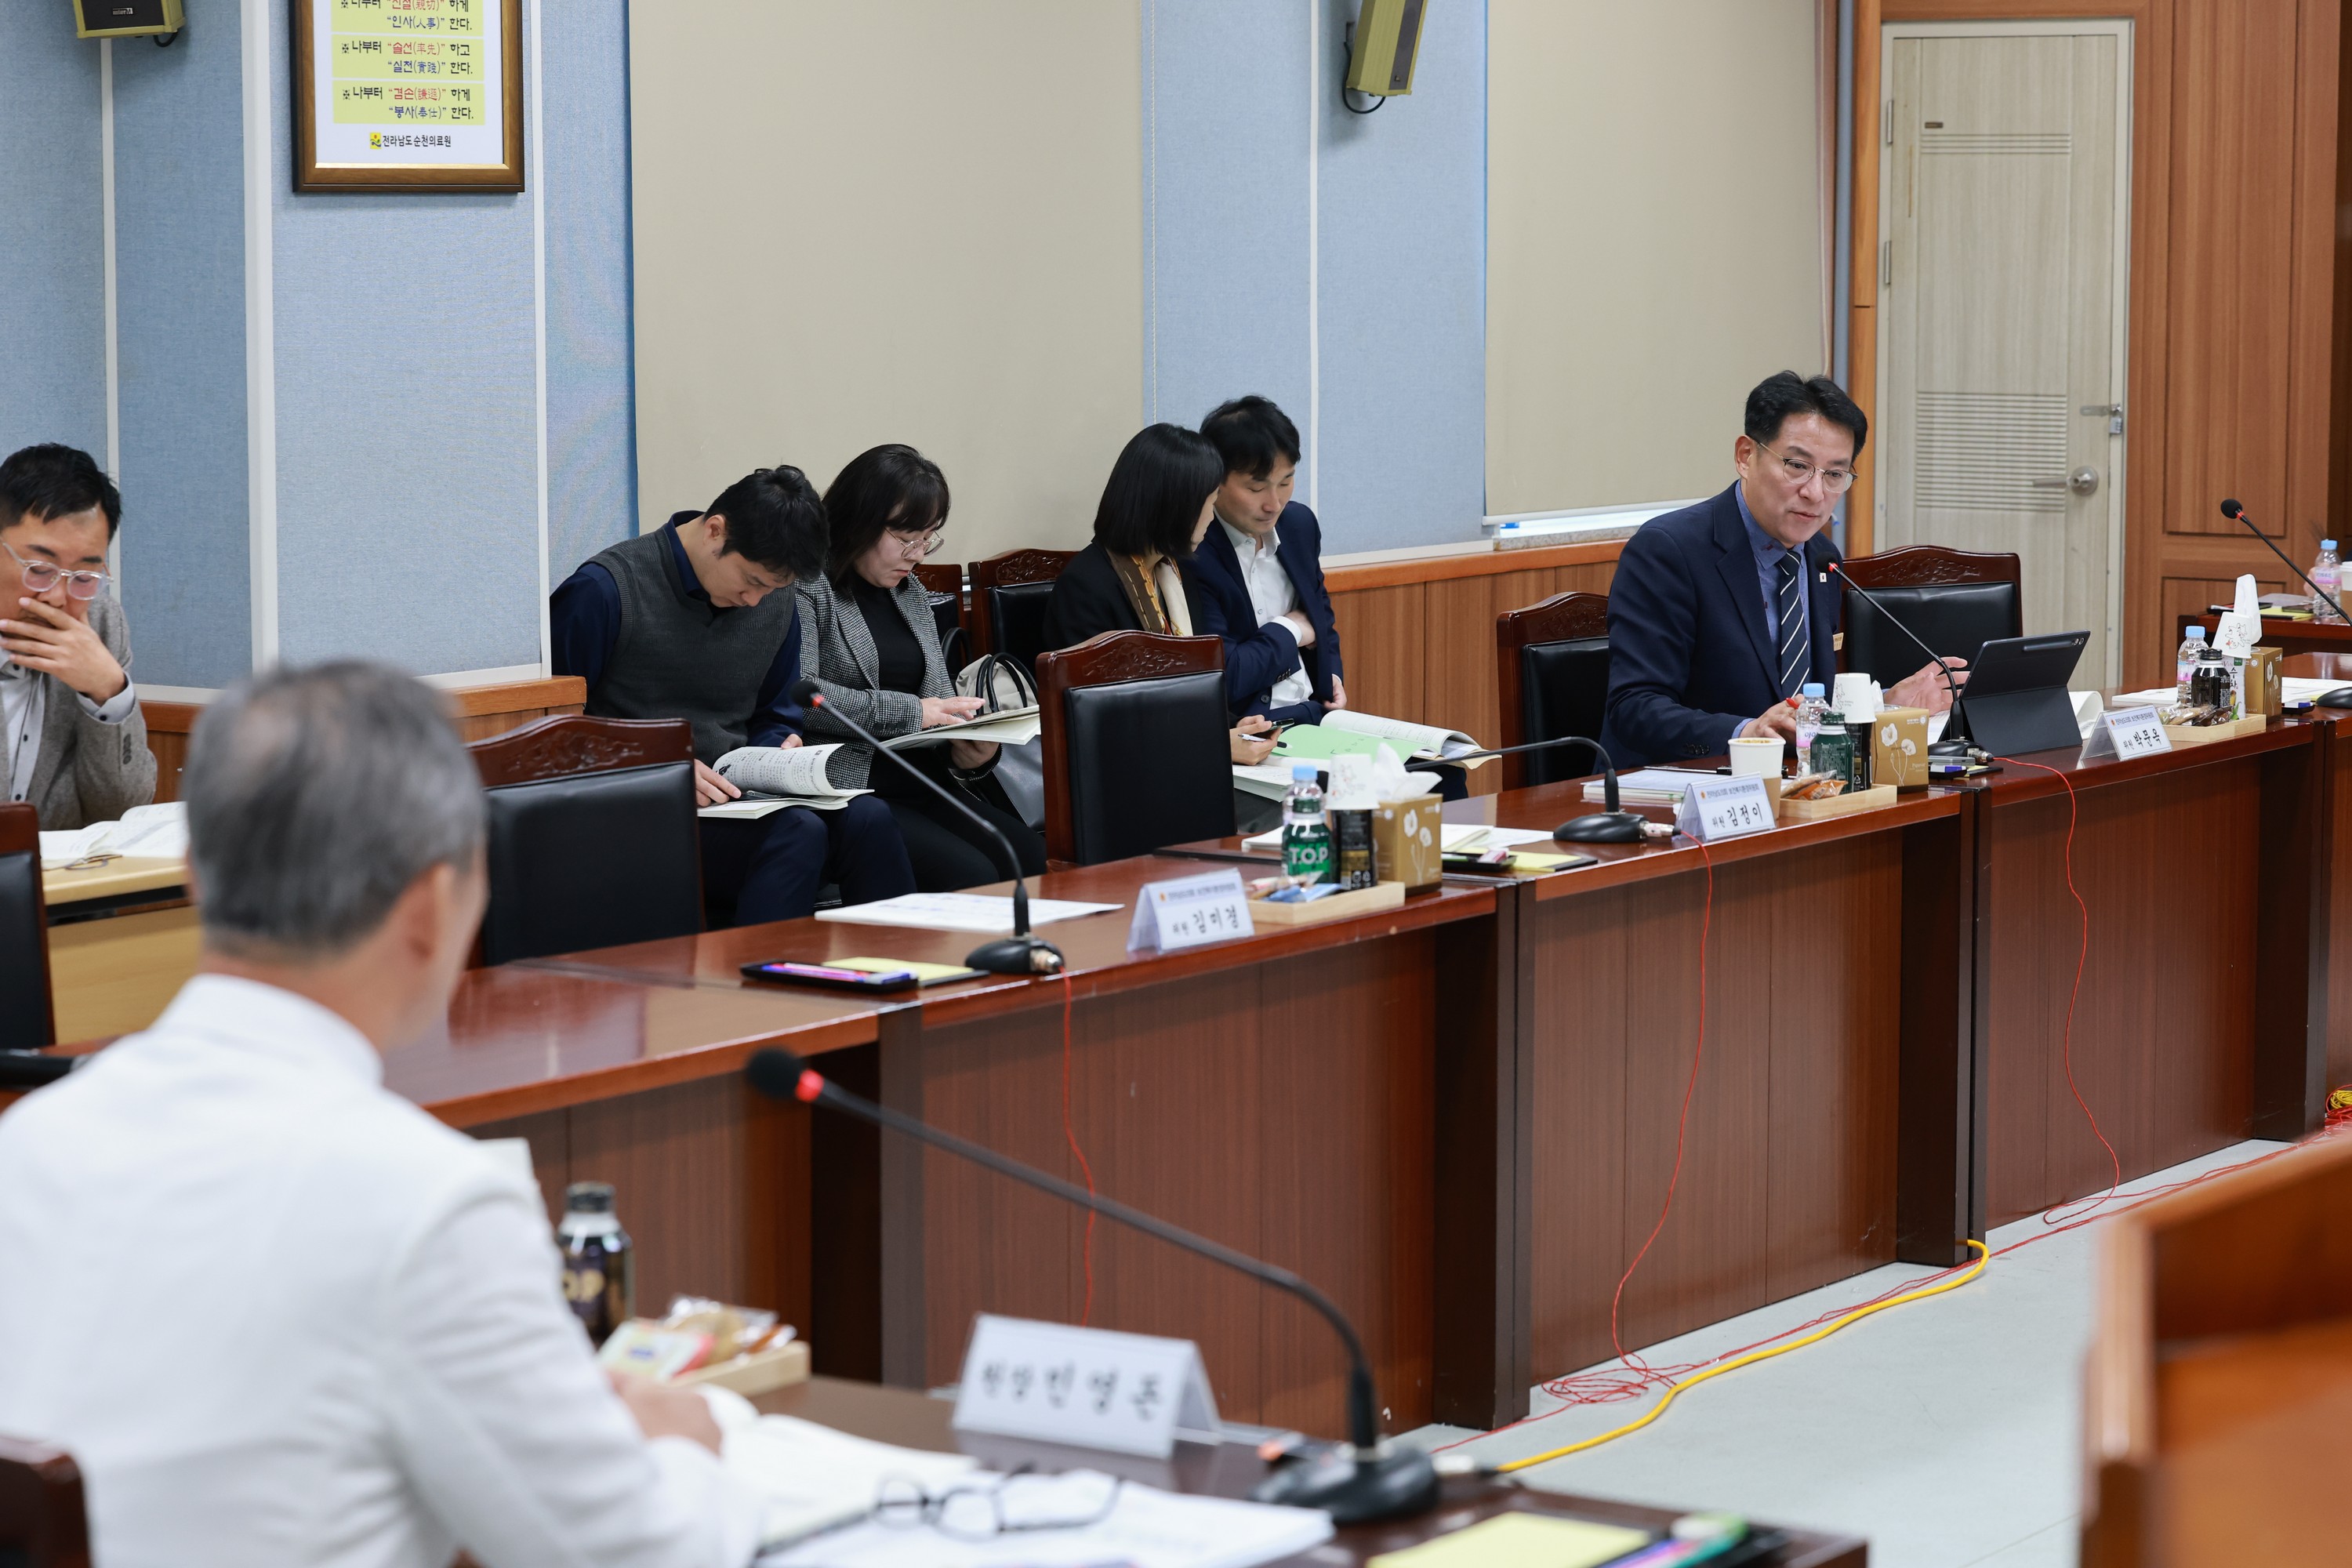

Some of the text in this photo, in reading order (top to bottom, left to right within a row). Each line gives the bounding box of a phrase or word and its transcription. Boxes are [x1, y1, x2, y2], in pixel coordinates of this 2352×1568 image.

[449, 0, 469, 13] 하게
[449, 17, 472, 31] 한다.
[352, 41, 382, 54] 나부터
[450, 43, 470, 56] 하고
[450, 62, 473, 74] 한다.
[353, 86, 383, 100] 나부터
[451, 89, 470, 101] 하게
[451, 107, 474, 120] 한다.
[2133, 728, 2162, 749] 박문옥
[1727, 802, 1763, 827] 김정이
